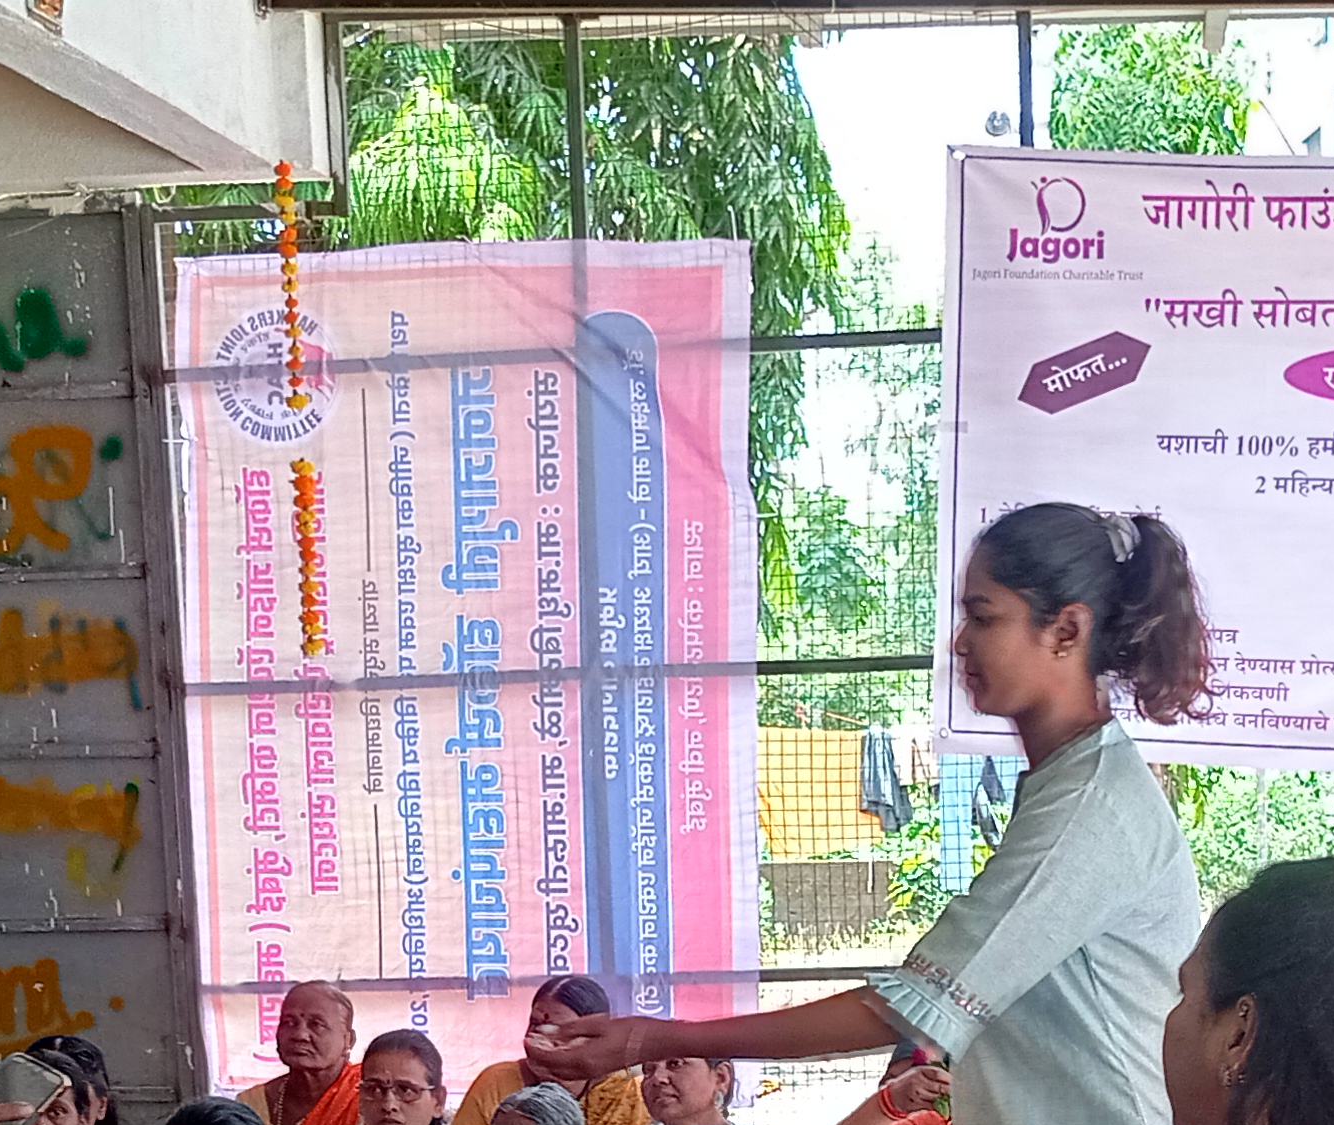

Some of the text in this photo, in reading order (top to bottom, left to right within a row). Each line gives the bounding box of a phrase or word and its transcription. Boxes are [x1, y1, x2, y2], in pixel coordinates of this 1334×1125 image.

[1142, 180, 1256, 232] जागोरी
[1006, 228, 1106, 265] Jagori
[972, 267, 1144, 282] Jagori Foundation Charitable Trust
[1156, 429, 1229, 455] यशाची
[1236, 435, 1300, 457] 100%
[1255, 475, 1267, 494] 2
[980, 507, 994, 524] 1.
[1234, 652, 1296, 675] देण्यास
[1233, 708, 1331, 732] बनविण्याचे
